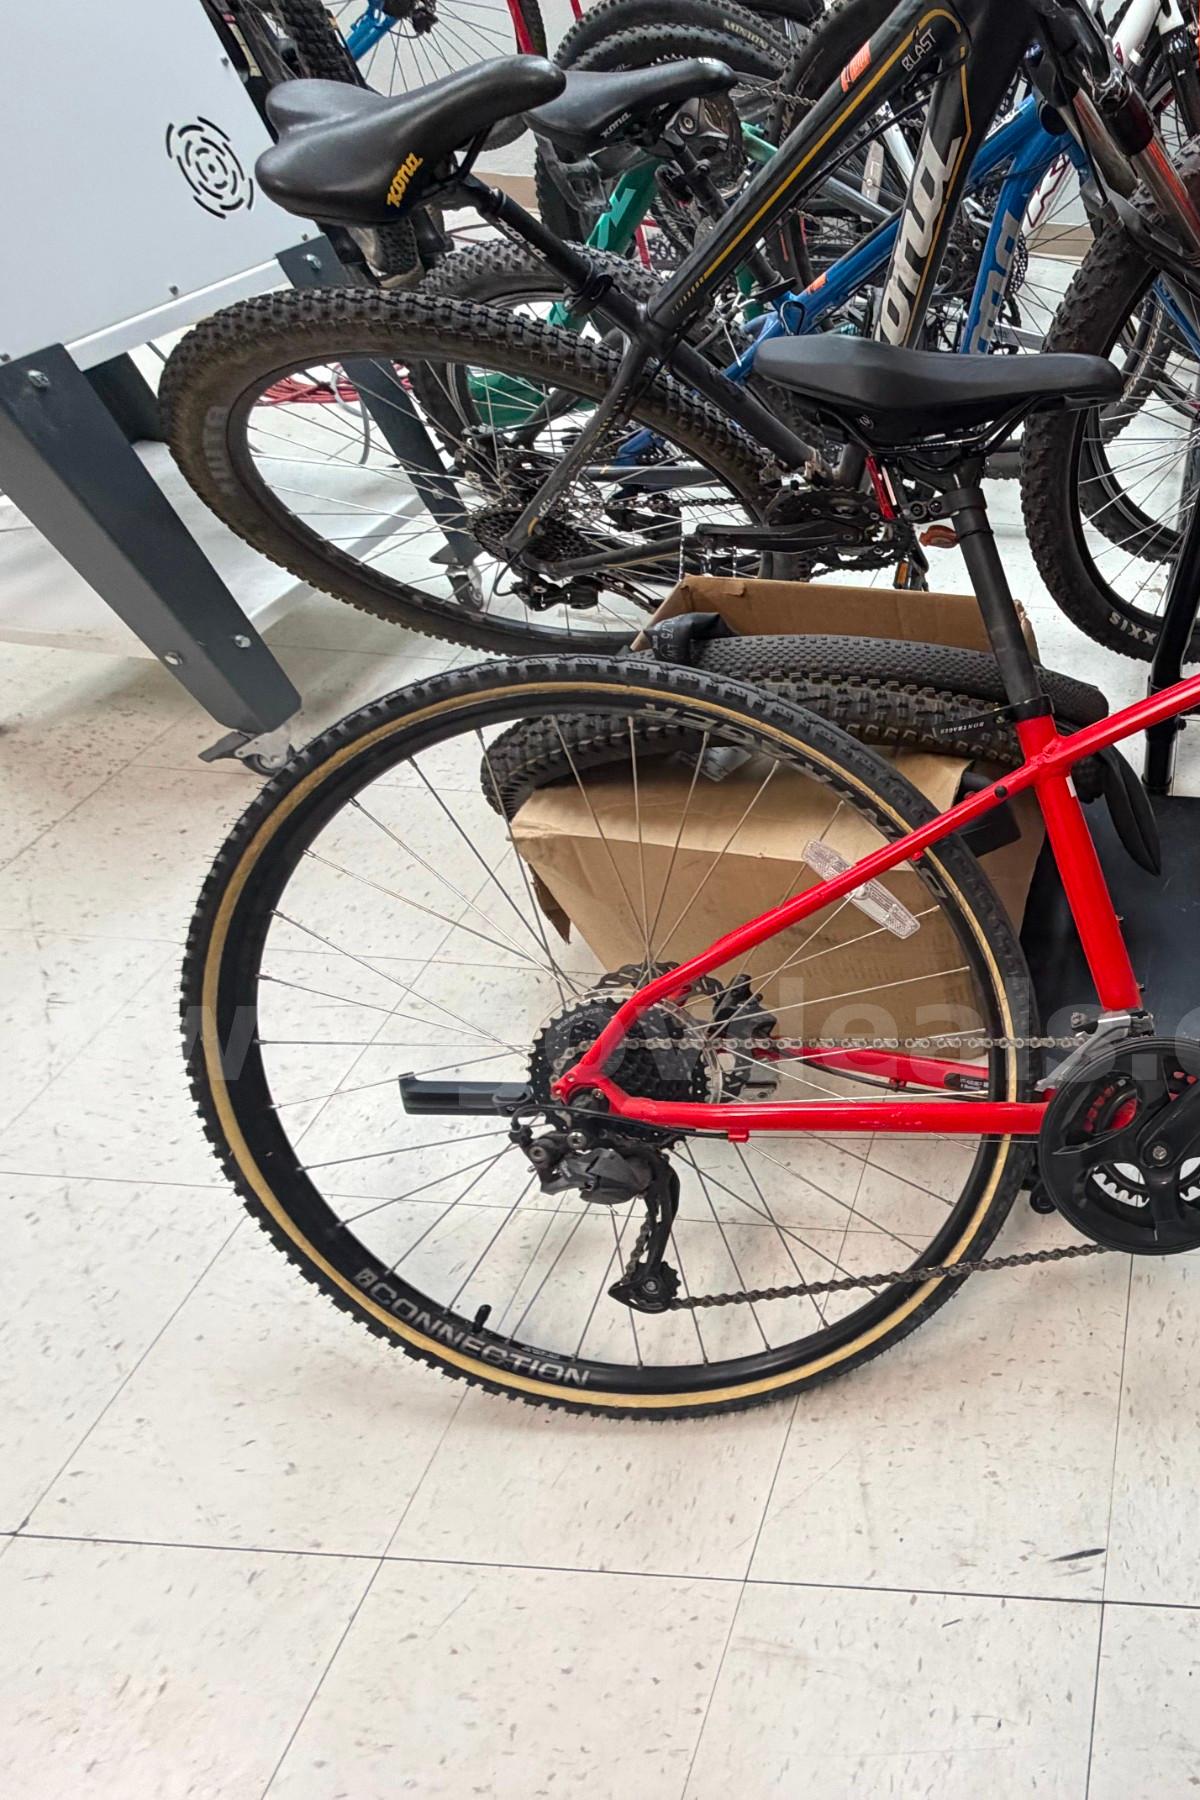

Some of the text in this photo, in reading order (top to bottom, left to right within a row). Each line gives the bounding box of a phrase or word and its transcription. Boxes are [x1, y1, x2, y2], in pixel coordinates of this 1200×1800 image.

[901, 27, 937, 72] BLAST
[940, 720, 985, 735] BONTRAGER
[632, 702, 947, 899] BNTRAGER
[370, 1281, 590, 1387] CONNECTION
